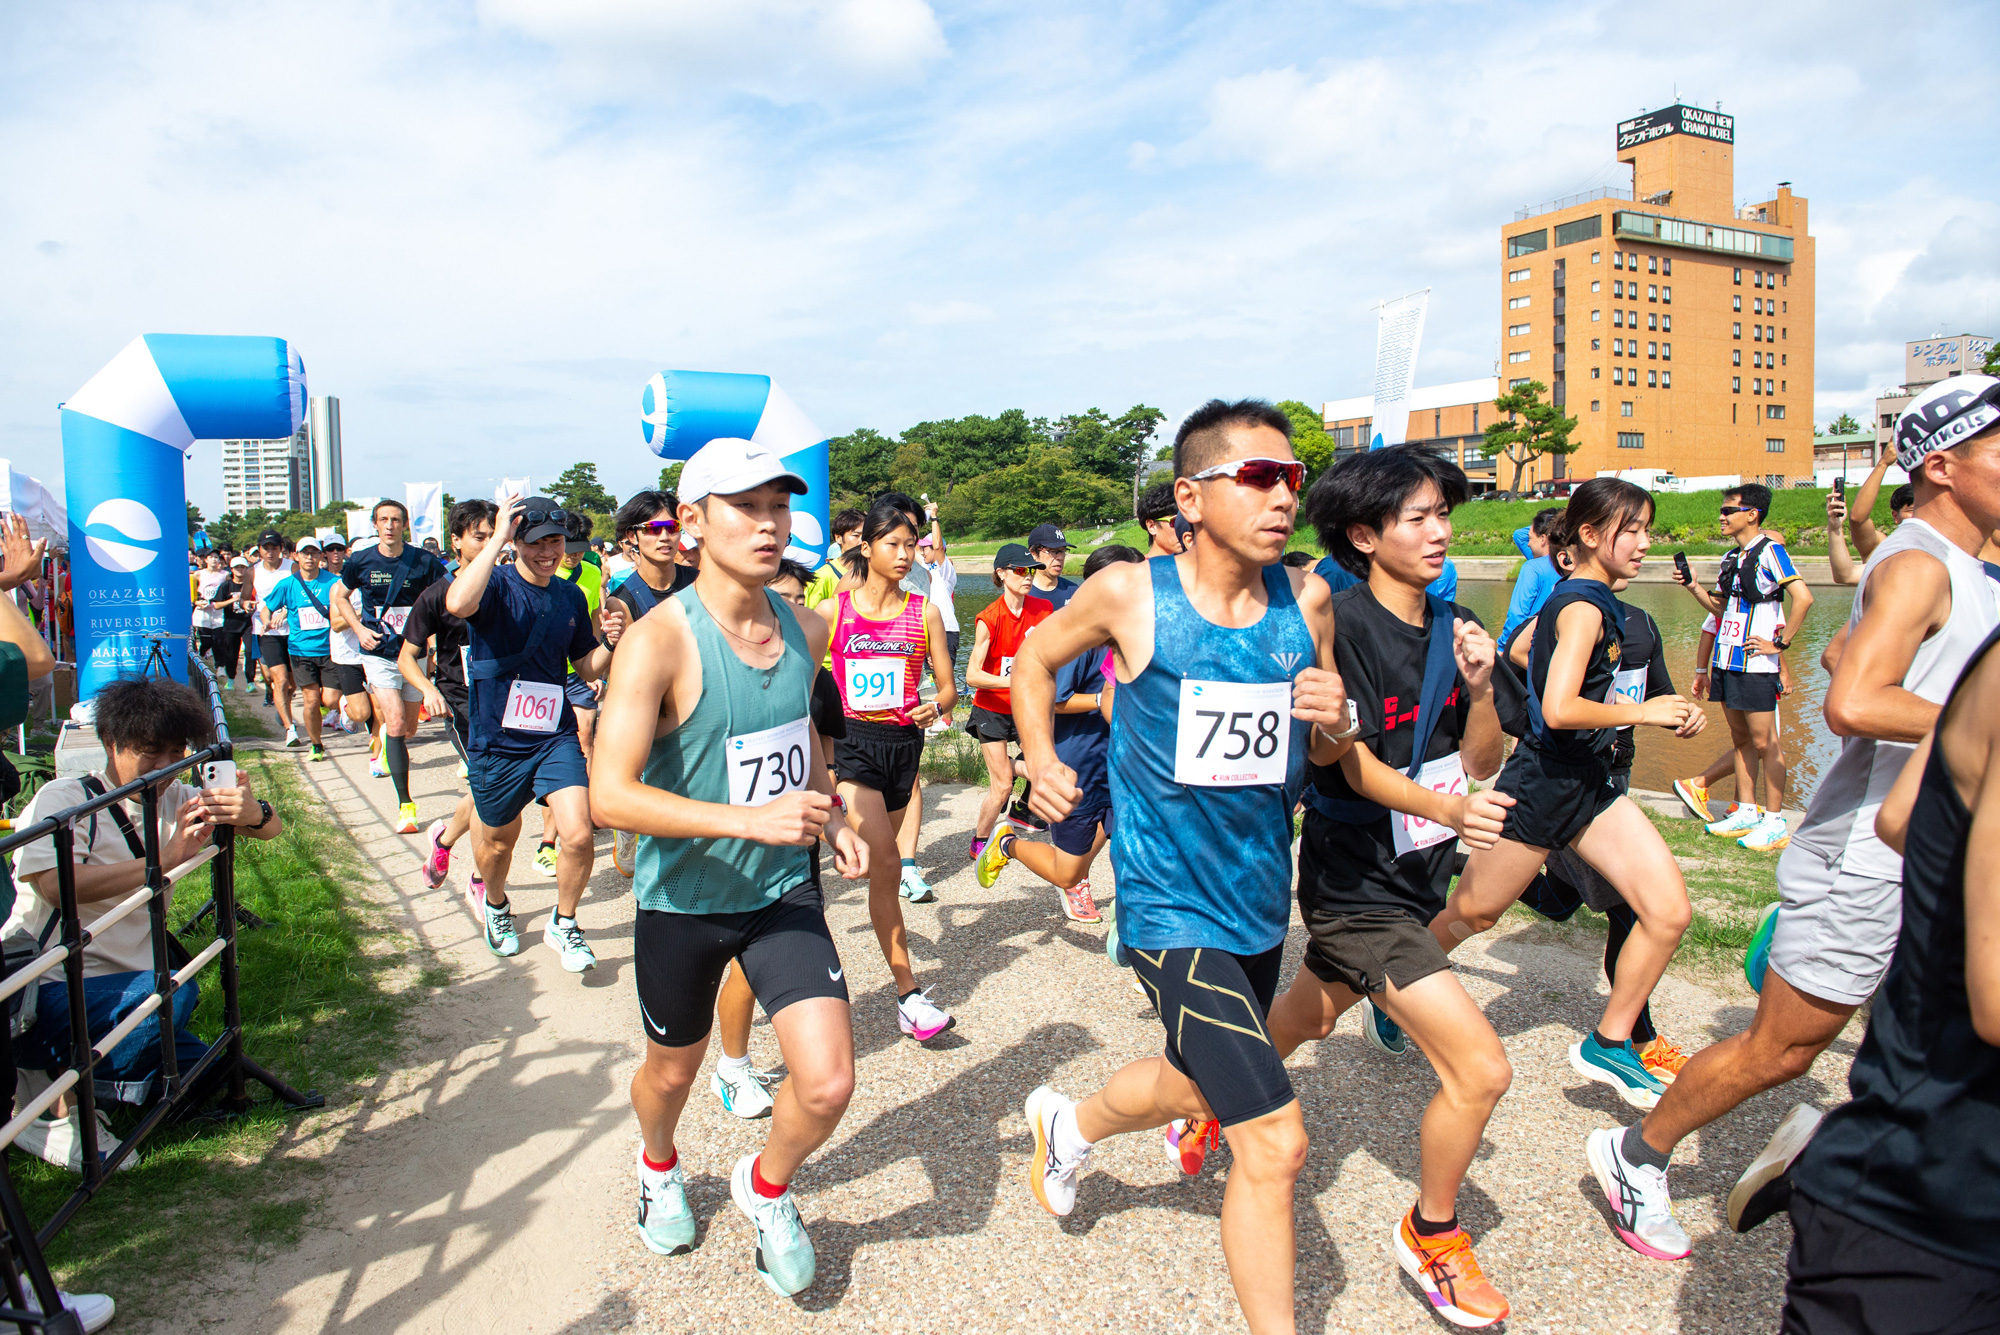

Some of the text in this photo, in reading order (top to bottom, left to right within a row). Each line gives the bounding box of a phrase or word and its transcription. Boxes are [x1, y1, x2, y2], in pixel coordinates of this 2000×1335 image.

[1681, 107, 1733, 129] OKAZAKI NEW
[1681, 119, 1733, 142] GRAND HOTEL
[1923, 353, 1960, 368] ホテル
[88, 588, 165, 599] OKAZAKI
[91, 616, 167, 628] RIVERSIDE
[92, 645, 169, 658] MARATHN
[852, 671, 895, 698] 991
[514, 694, 557, 721] 1061
[1195, 710, 1280, 761] 758
[740, 744, 805, 803] 730
[1231, 773, 1258, 782] COLLECTION
[1420, 833, 1447, 845] RUN COLLECTION
